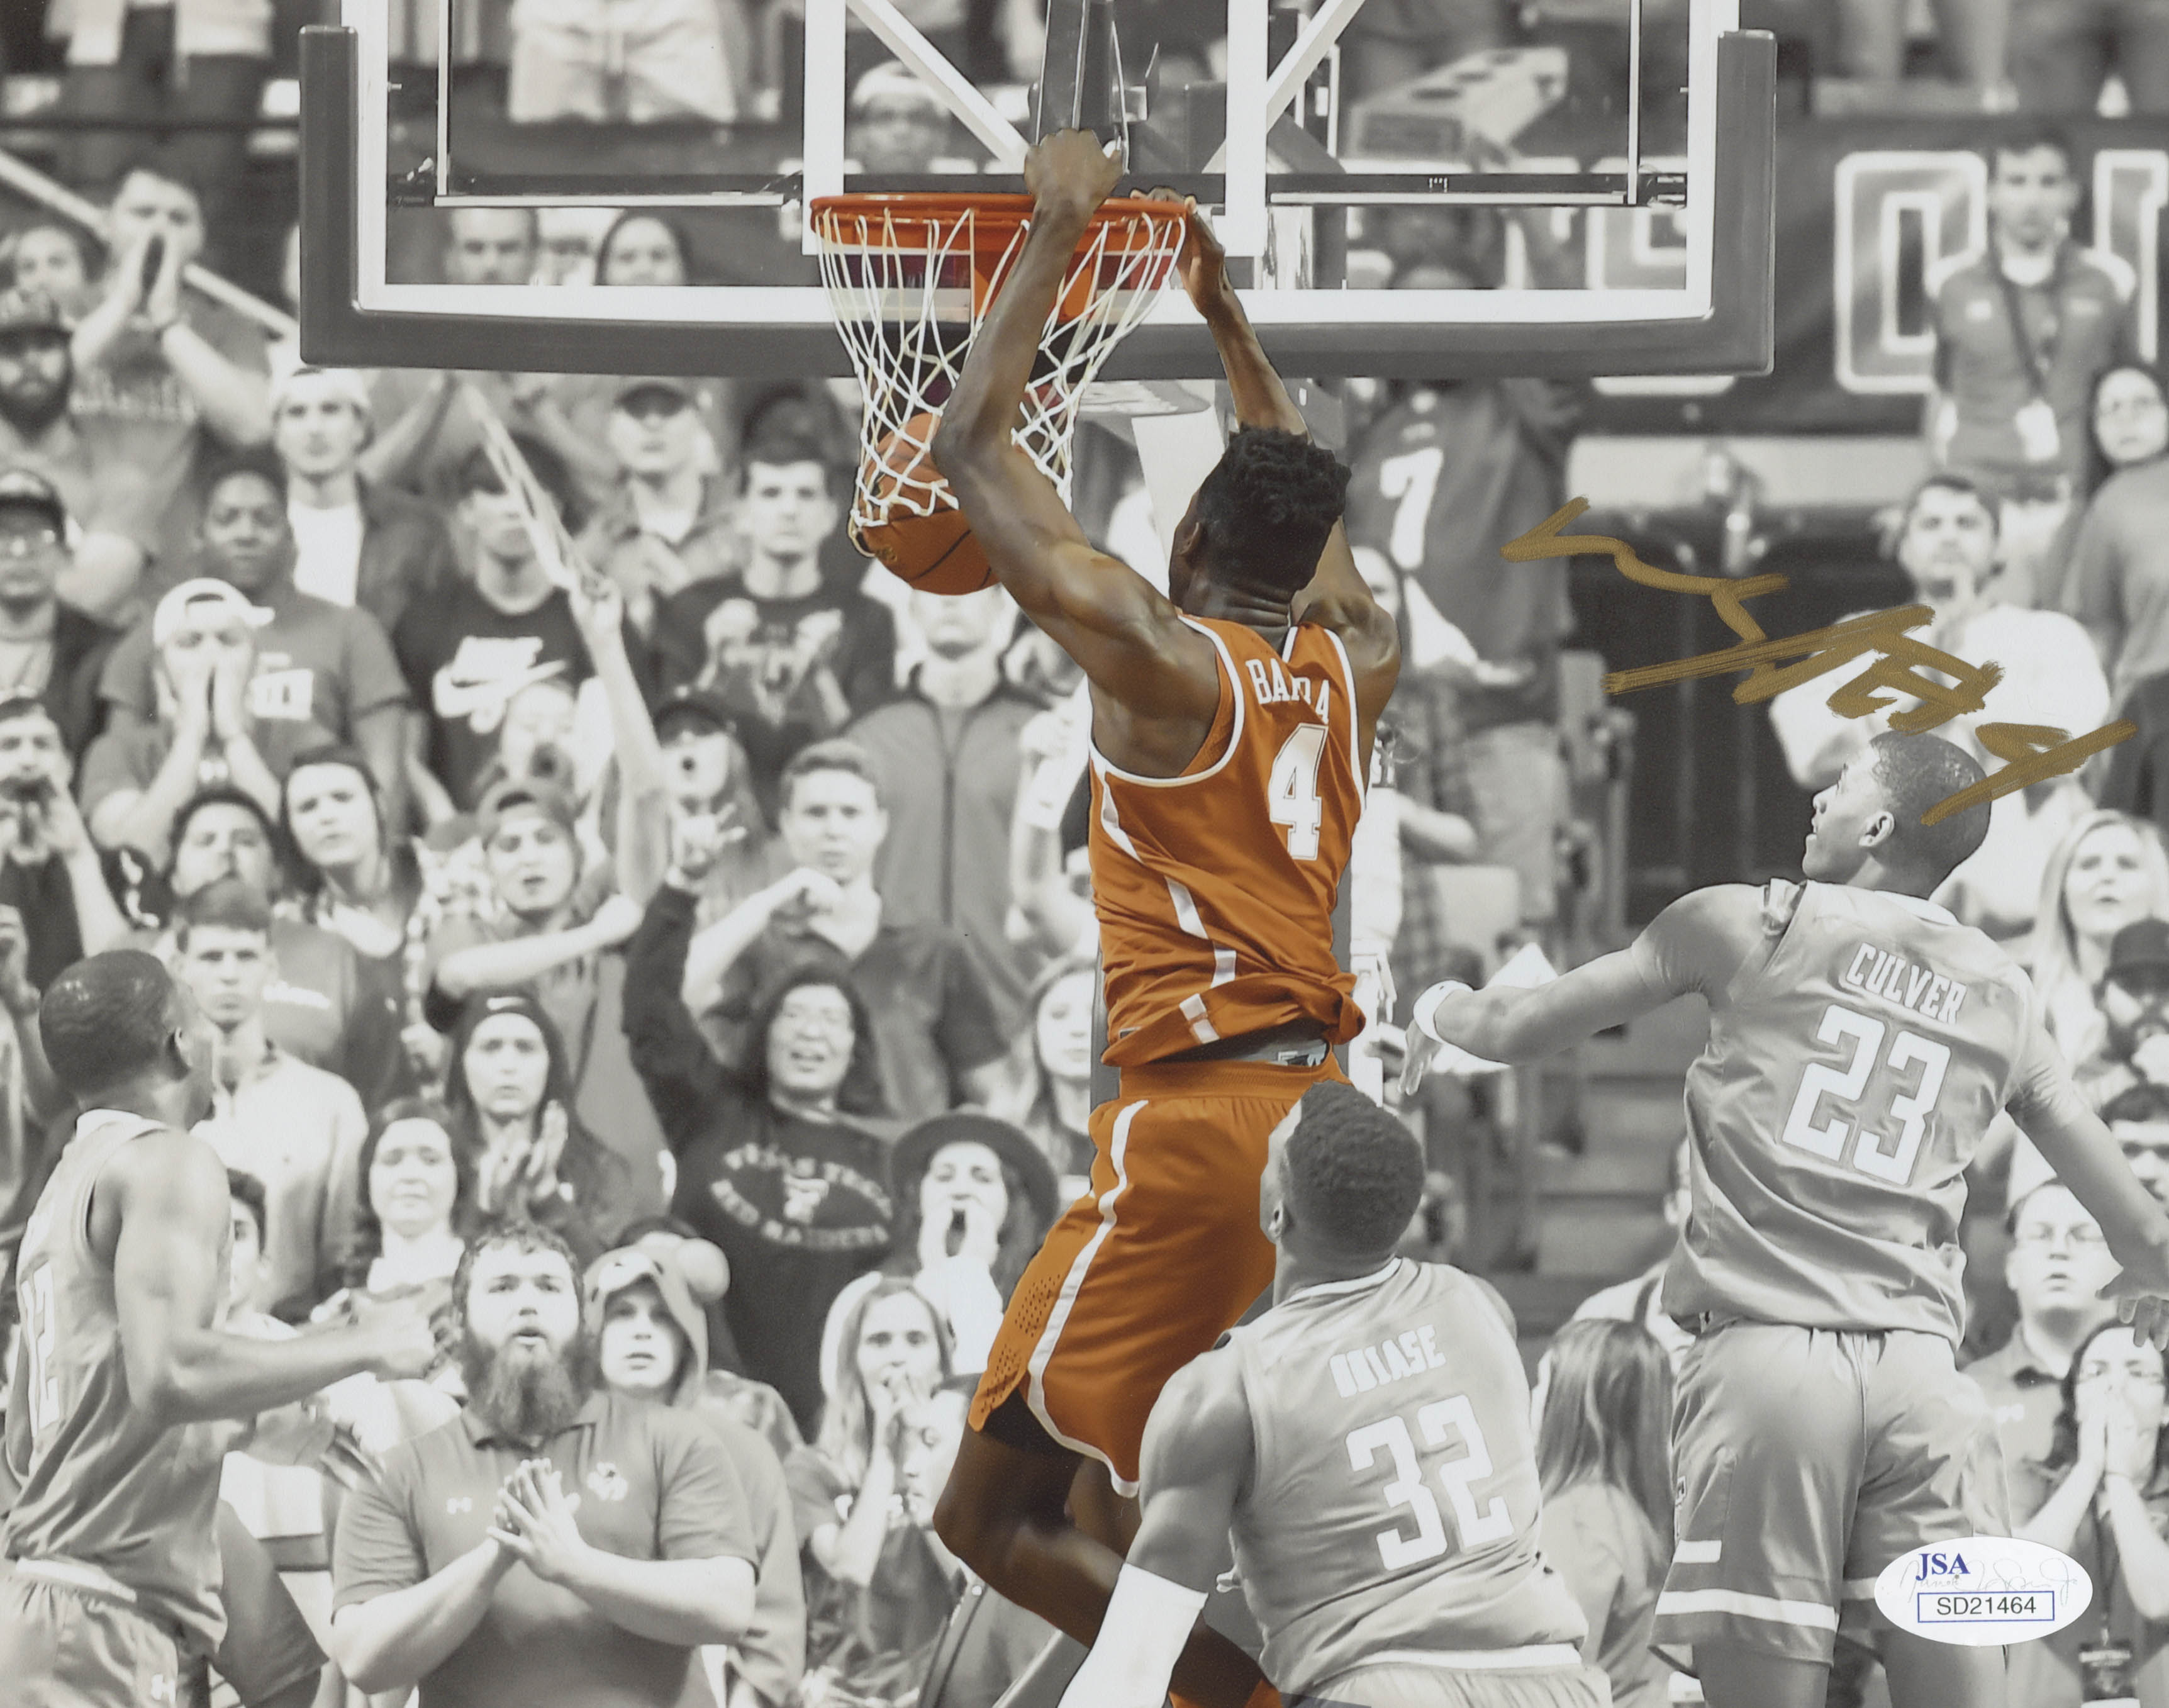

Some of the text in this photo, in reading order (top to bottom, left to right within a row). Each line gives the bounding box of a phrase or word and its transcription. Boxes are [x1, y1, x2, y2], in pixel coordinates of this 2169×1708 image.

[1380, 447, 1444, 570] 7
[1268, 723, 1329, 861] 4
[1845, 942, 1968, 1025] CULVER
[1781, 1003, 1951, 1186] 23
[1345, 1394, 1515, 1571] 32
[1915, 1553, 1971, 1582] JSA
[1936, 1596, 2037, 1616] SD21464
